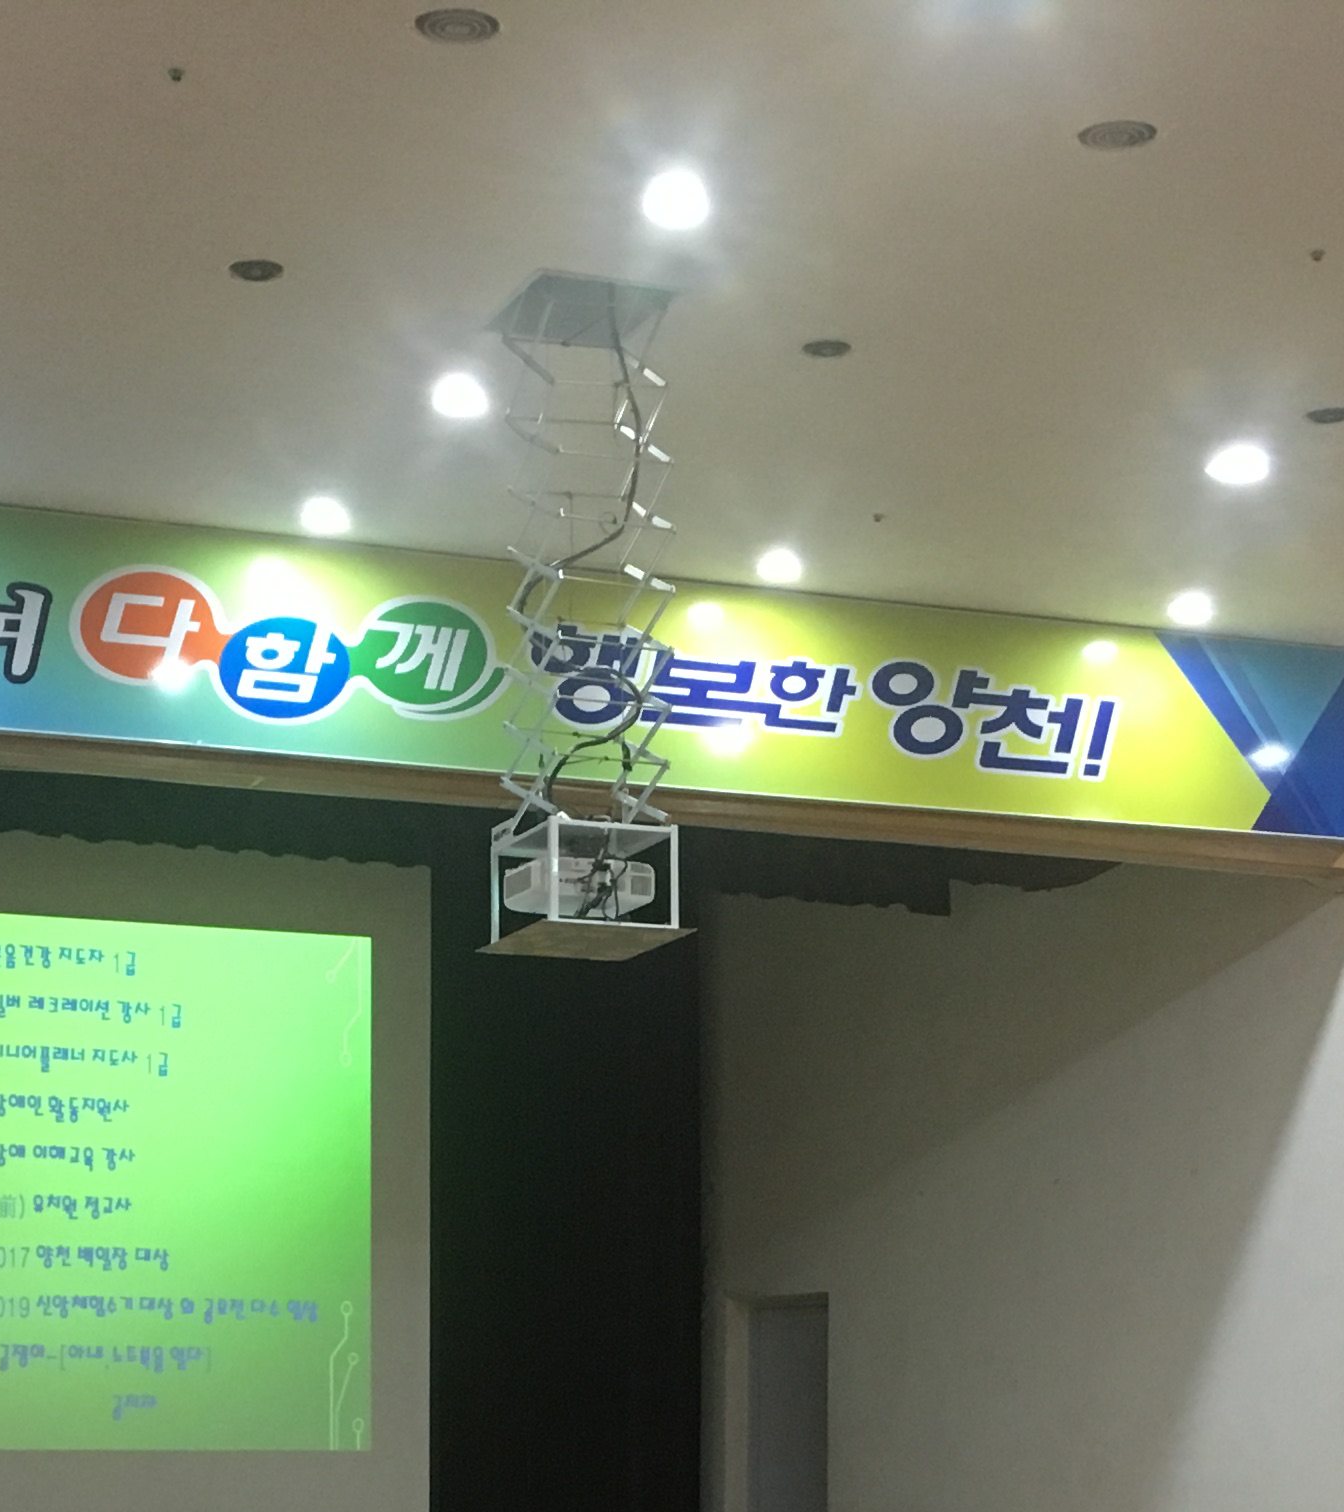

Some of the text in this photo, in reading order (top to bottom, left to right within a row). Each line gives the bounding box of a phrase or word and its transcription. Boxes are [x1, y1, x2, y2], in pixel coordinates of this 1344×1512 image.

[100, 592, 470, 704] 다함께
[530, 622, 857, 735] 행복한
[871, 661, 1116, 777] 양천!
[27, 995, 111, 1021] 레크레이션
[116, 1000, 151, 1024] 강사
[92, 1048, 138, 1066] 지도사
[32, 1145, 94, 1172] 이해교육
[101, 1147, 136, 1171] 강사
[32, 1194, 79, 1220] 유치원
[84, 1195, 132, 1220] 정교사
[35, 1245, 72, 1269] 양천
[77, 1246, 128, 1271] 백일장
[134, 1247, 170, 1271] 대상
[138, 1296, 173, 1320] 대상
